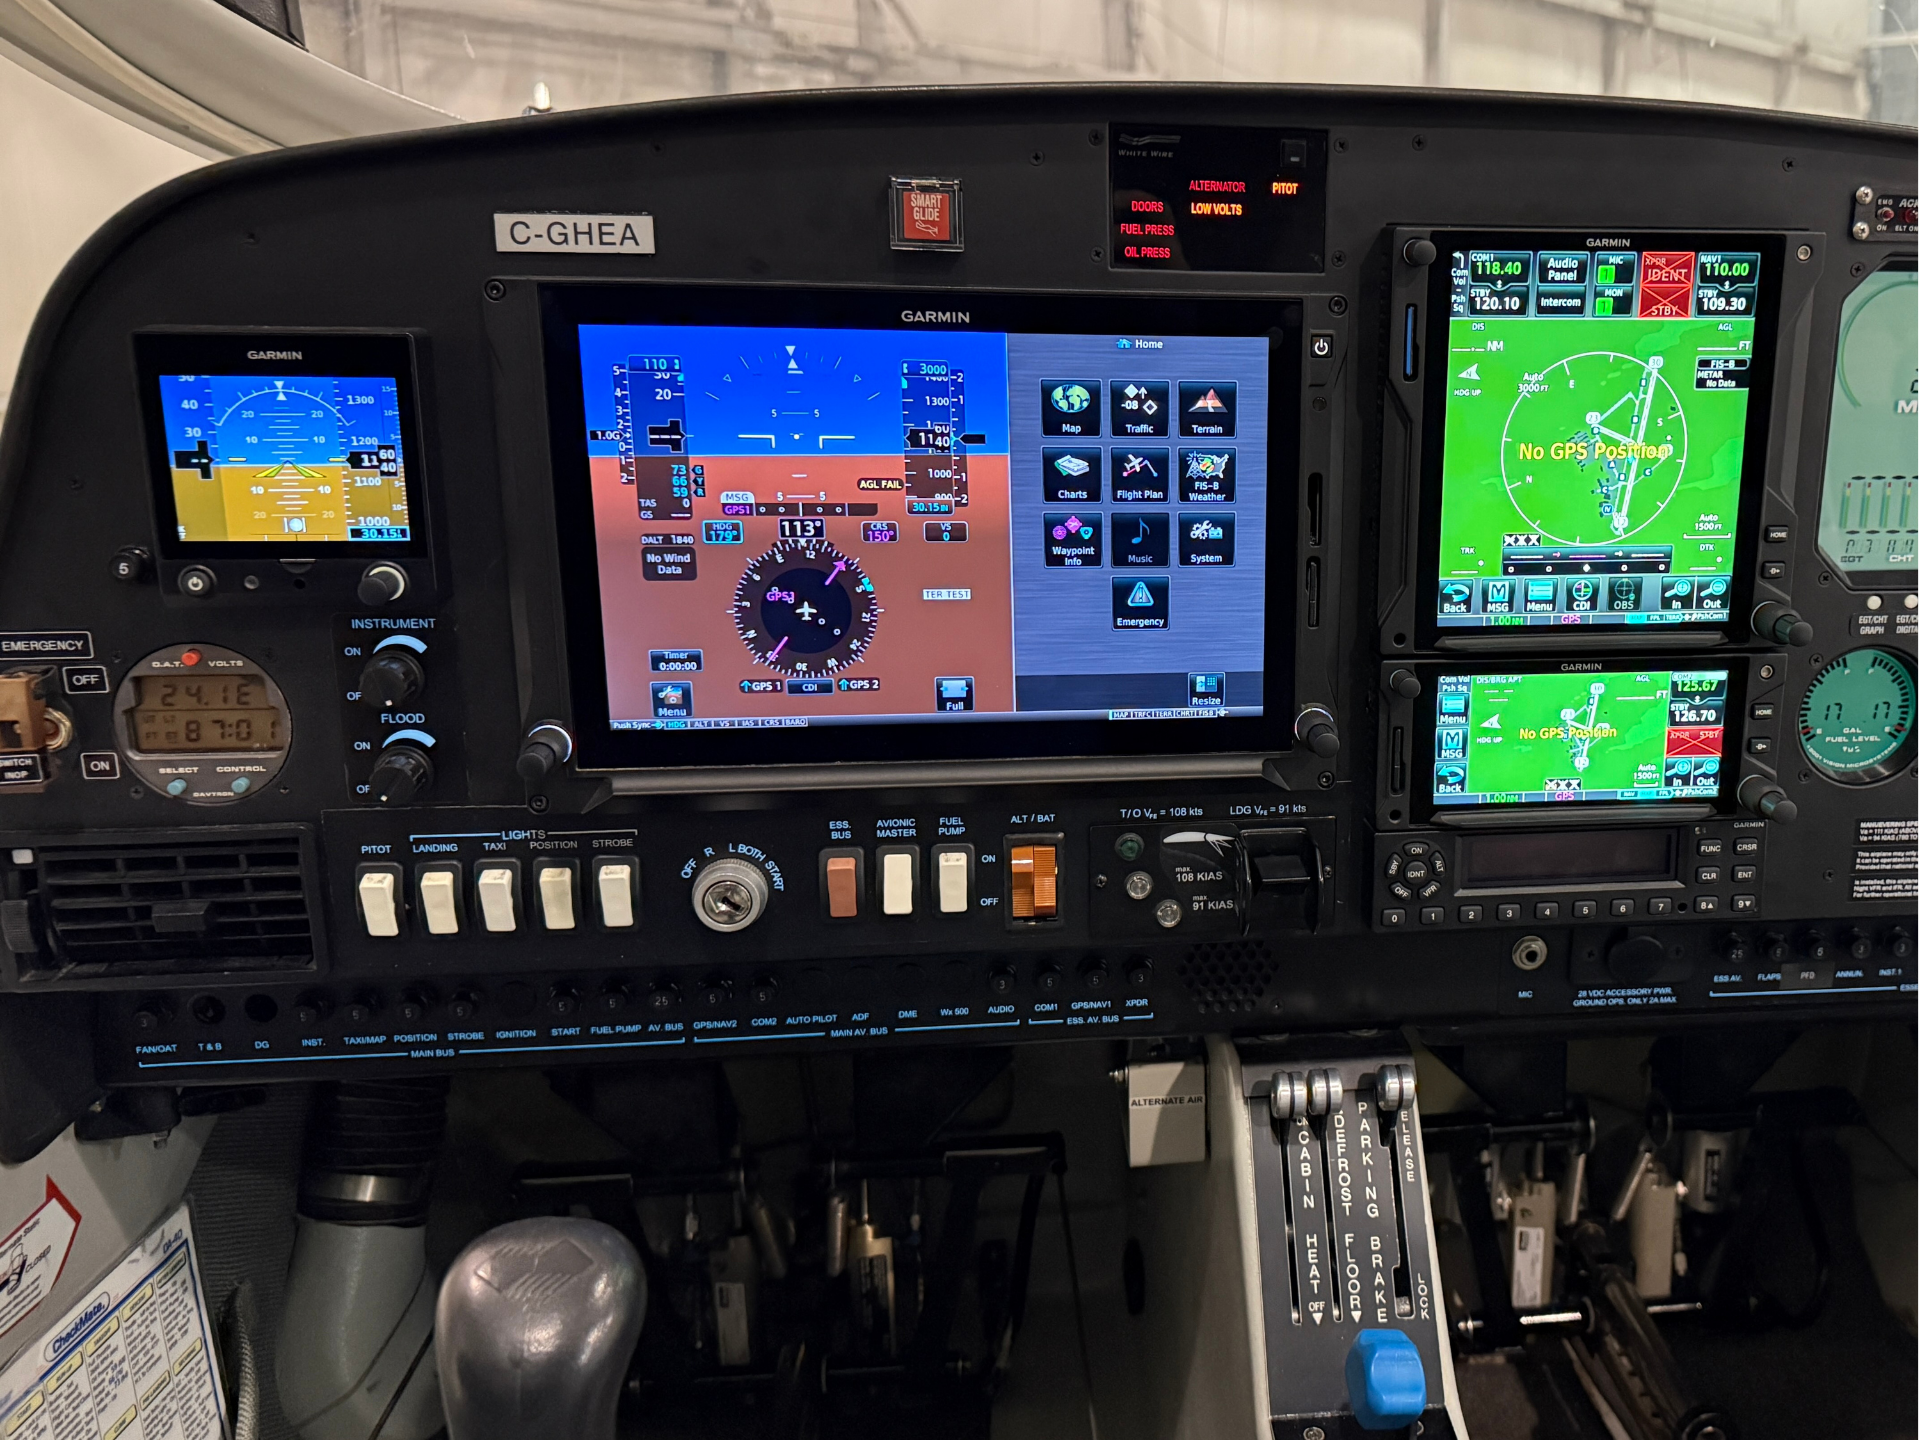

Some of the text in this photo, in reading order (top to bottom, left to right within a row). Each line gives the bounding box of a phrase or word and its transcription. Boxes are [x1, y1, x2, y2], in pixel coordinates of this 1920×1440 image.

[1189, 180, 1246, 193] ALTERNATOR
[1272, 182, 1298, 194] PITOT
[910, 194, 942, 208] SMART
[1132, 201, 1163, 212] DOORS
[1191, 203, 1242, 216] LOW VOLTS
[913, 208, 940, 221] GLIDE
[509, 221, 640, 248] C-GHEA
[1121, 224, 1174, 236] FUEL PRESS
[1586, 238, 1630, 248] GARMIN
[1125, 246, 1170, 258] OIL PRESS
[1547, 257, 1578, 269] Audio
[1609, 255, 1623, 265] MIC
[1476, 261, 1521, 276] 118.40
[1704, 262, 1749, 277] 110.00
[1548, 269, 1577, 282] Panel
[1474, 297, 1520, 311] 120.10
[1540, 296, 1581, 308] Intercom
[1701, 297, 1746, 311] 109.30
[901, 310, 970, 323] GARMIN
[1135, 340, 1163, 349] Home
[247, 350, 302, 360] GARMIN
[1706, 379, 1736, 388] No Data
[347, 395, 374, 404] 1300
[926, 396, 949, 406] 1300
[1062, 424, 1081, 435] Map
[1126, 425, 1153, 434] Traffic
[1192, 425, 1223, 434] Terrain
[1519, 442, 1669, 460] No GPS Position
[1058, 490, 1088, 499] Charts
[1117, 490, 1163, 501] Flight Plan
[1189, 492, 1225, 501] Weather
[781, 520, 821, 537] 113°
[1052, 546, 1094, 556] Waypoint
[646, 552, 690, 564] No Wind
[1128, 555, 1153, 563] Music
[1191, 554, 1222, 564] System
[657, 564, 682, 575] Data
[1443, 602, 1467, 613] Back
[1487, 602, 1509, 612] MSG
[1526, 601, 1553, 611] Menu
[1573, 601, 1590, 610] CDI
[351, 619, 436, 629] INSTRUMENT
[1117, 617, 1164, 628] Emergency
[1859, 615, 1888, 624] EGT/CHT
[1896, 626, 1918, 634] DIGITA
[2, 640, 83, 651] EMERGENCY
[344, 647, 360, 656] ON
[1560, 662, 1602, 672] GARMIN
[72, 675, 100, 685] OFF
[945, 700, 965, 711] Full
[1192, 696, 1221, 705] Resize
[657, 706, 686, 717] Menu
[381, 714, 425, 724] FLOOD
[1439, 715, 1466, 724] Menu
[1519, 726, 1617, 740] No GPS Position
[354, 742, 370, 750] ON
[1441, 749, 1463, 758] MSG
[90, 761, 109, 771] ON
[5, 771, 29, 779] INOP
[1438, 784, 1462, 793] Back
[829, 821, 851, 830] ESS.
[876, 818, 916, 828] AVIONIC
[939, 817, 964, 826] FUEL
[501, 829, 546, 840] LIGHTS
[831, 830, 851, 839] BUS
[876, 828, 916, 838] MASTER
[938, 826, 966, 836] PUMP
[412, 843, 458, 853] LANDING
[483, 842, 506, 851] TAXI
[529, 840, 578, 850] POSITION
[592, 838, 634, 848] STROBE
[1737, 843, 1757, 851] CRSR
[361, 845, 391, 855] PITOT
[738, 844, 766, 861] BOTH
[981, 854, 996, 863] ON
[681, 858, 696, 878] OFF
[1176, 871, 1223, 882] 108 KIAS
[1702, 872, 1717, 880] CLR
[1394, 886, 1408, 898] OFF
[980, 897, 999, 906] OFF
[1193, 900, 1233, 911] 91 KIAS
[1758, 973, 1781, 981] FLAPS
[1836, 969, 1863, 978] ANNUN.
[1518, 990, 1533, 998] MIC
[1606, 988, 1652, 996] ACCESSORY
[1125, 998, 1148, 1007] XPDR
[1573, 999, 1606, 1007] GROUND
[1627, 997, 1648, 1005] ONLY
[988, 1005, 1015, 1014] AUDIO
[1034, 1003, 1058, 1012] COM1
[851, 1012, 869, 1021] ADF
[898, 1010, 918, 1018] DME
[785, 1014, 837, 1025] AUTO PILOT
[496, 1030, 536, 1039] IGNITION
[551, 1027, 581, 1036] START
[590, 1024, 641, 1035] FUEL PUMP
[830, 1026, 888, 1037] MAIN AV. BUS
[393, 1033, 437, 1043] POSITION
[447, 1031, 485, 1041] STROBE
[136, 1044, 177, 1054] FAN/OAT
[254, 1040, 269, 1049] DG
[411, 1048, 455, 1058] MAIN BUS
[1130, 1095, 1203, 1107] ALTERNATE AIR
[1401, 1110, 1415, 1182] ELEASE
[1358, 1102, 1379, 1218] PARKING
[1298, 1131, 1315, 1208] CABIN
[1335, 1115, 1352, 1216] DEFROST
[1306, 1234, 1320, 1294] HEAT
[1345, 1233, 1363, 1308] FLOOR
[1370, 1236, 1388, 1322] BRAKE
[1418, 1273, 1430, 1320] LOCK
[1309, 1301, 1325, 1311] OFF
